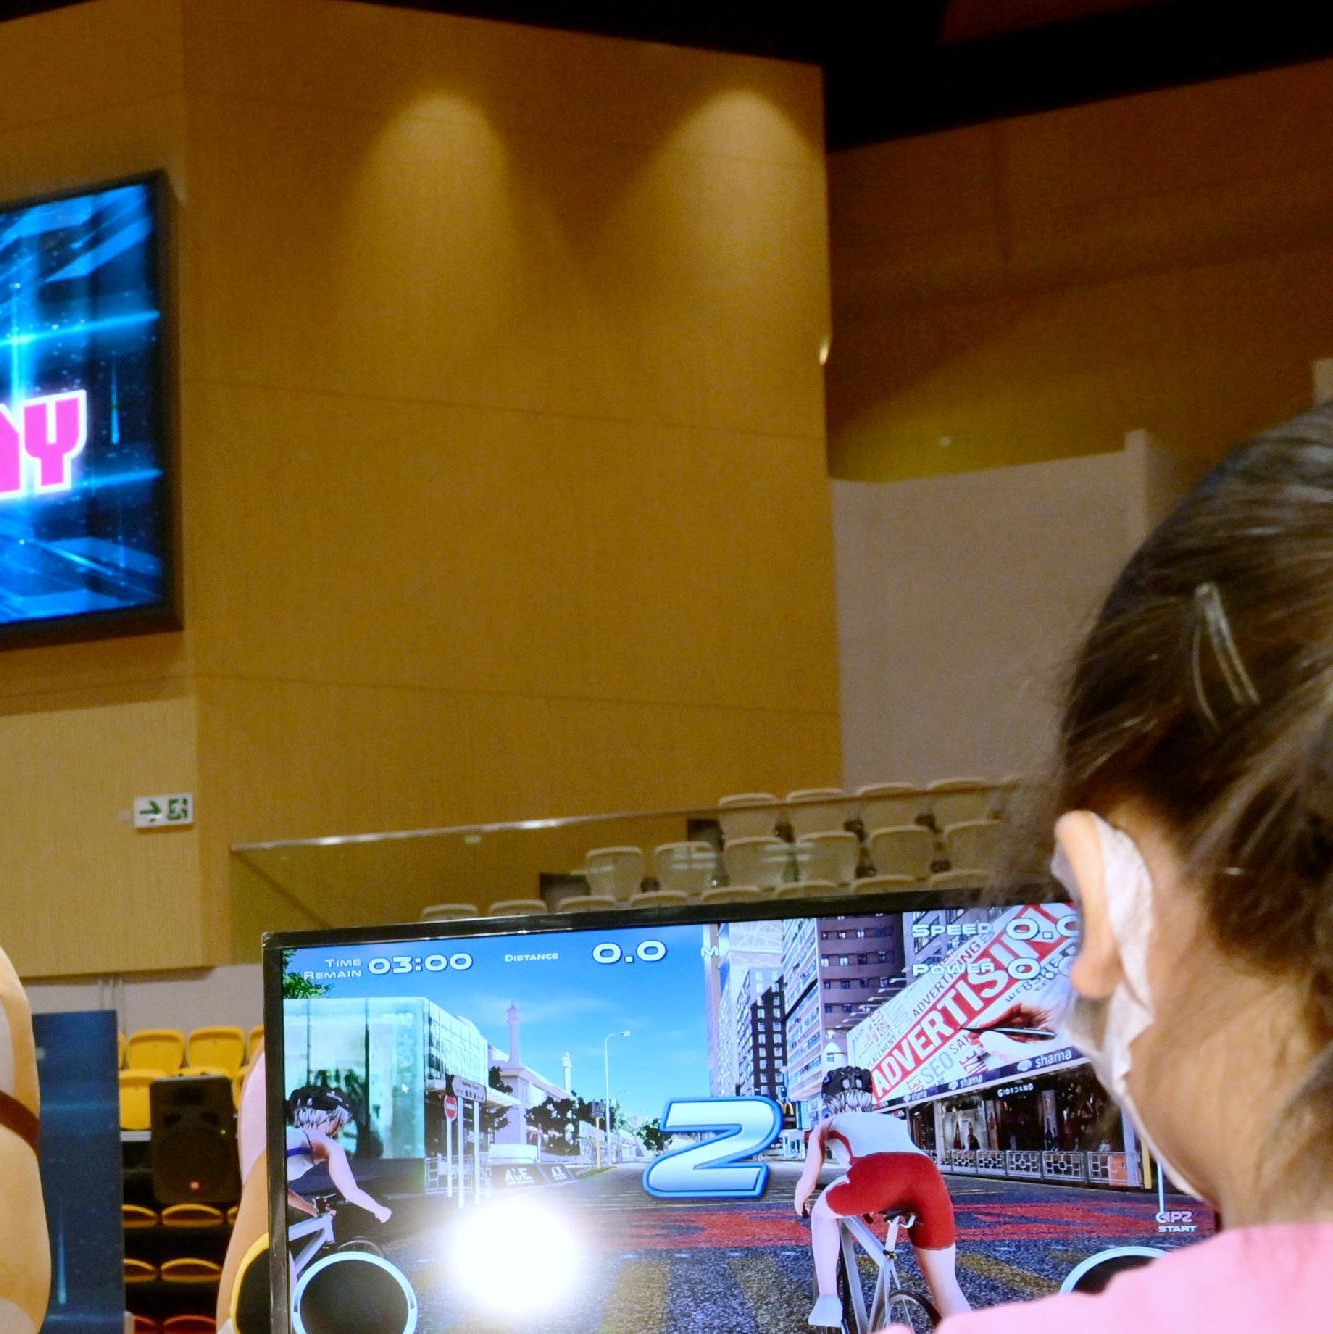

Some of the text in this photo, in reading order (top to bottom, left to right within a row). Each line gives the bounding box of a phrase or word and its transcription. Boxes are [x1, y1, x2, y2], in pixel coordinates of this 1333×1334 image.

[912, 922, 994, 938] SPEED
[591, 939, 667, 965] 0.0
[325, 958, 362, 969] TIME
[367, 953, 474, 975] 03:00
[912, 963, 995, 977] POWER
[1036, 1048, 1072, 1067] shama
[642, 1096, 784, 1200] 2
[1158, 1225, 1197, 1233] START
